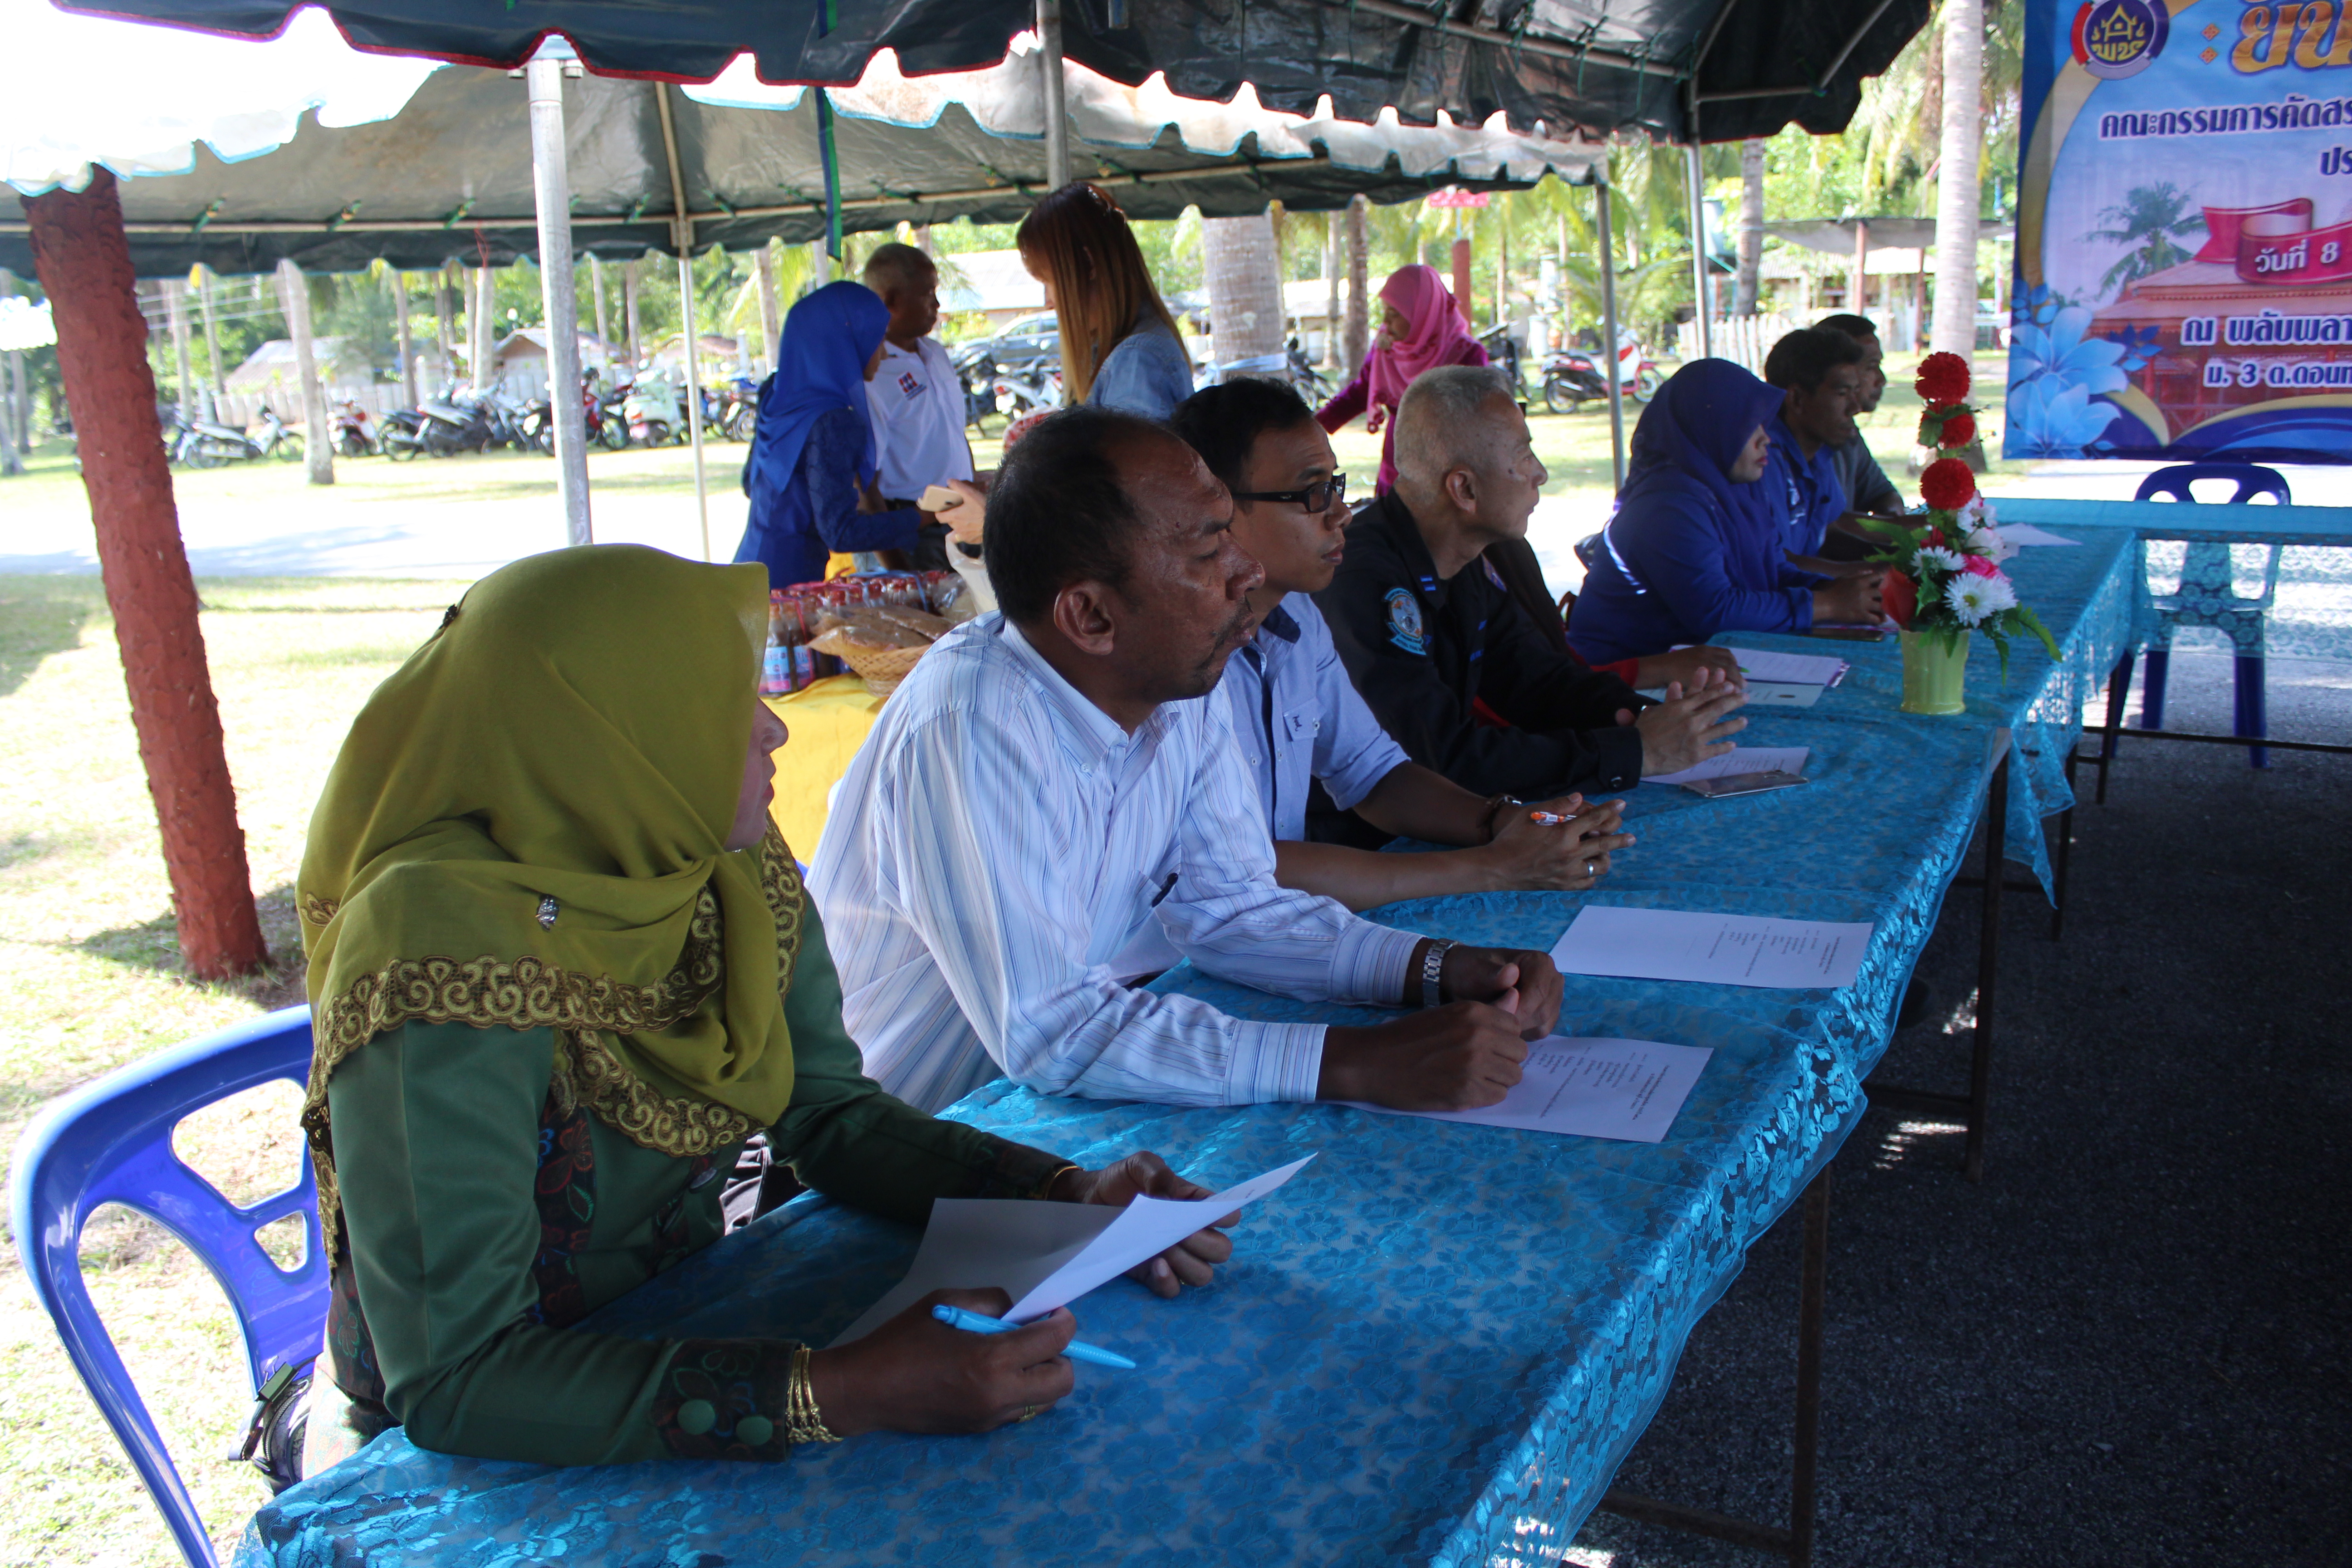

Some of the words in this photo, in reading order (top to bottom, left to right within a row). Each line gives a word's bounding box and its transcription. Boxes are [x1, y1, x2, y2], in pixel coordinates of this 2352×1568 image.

[2254, 239, 2311, 273] วันที่
[2320, 241, 2339, 264] 8
[2184, 319, 2215, 342] ณ
[2208, 366, 2229, 383] ม.
[2242, 363, 2257, 384] 3
